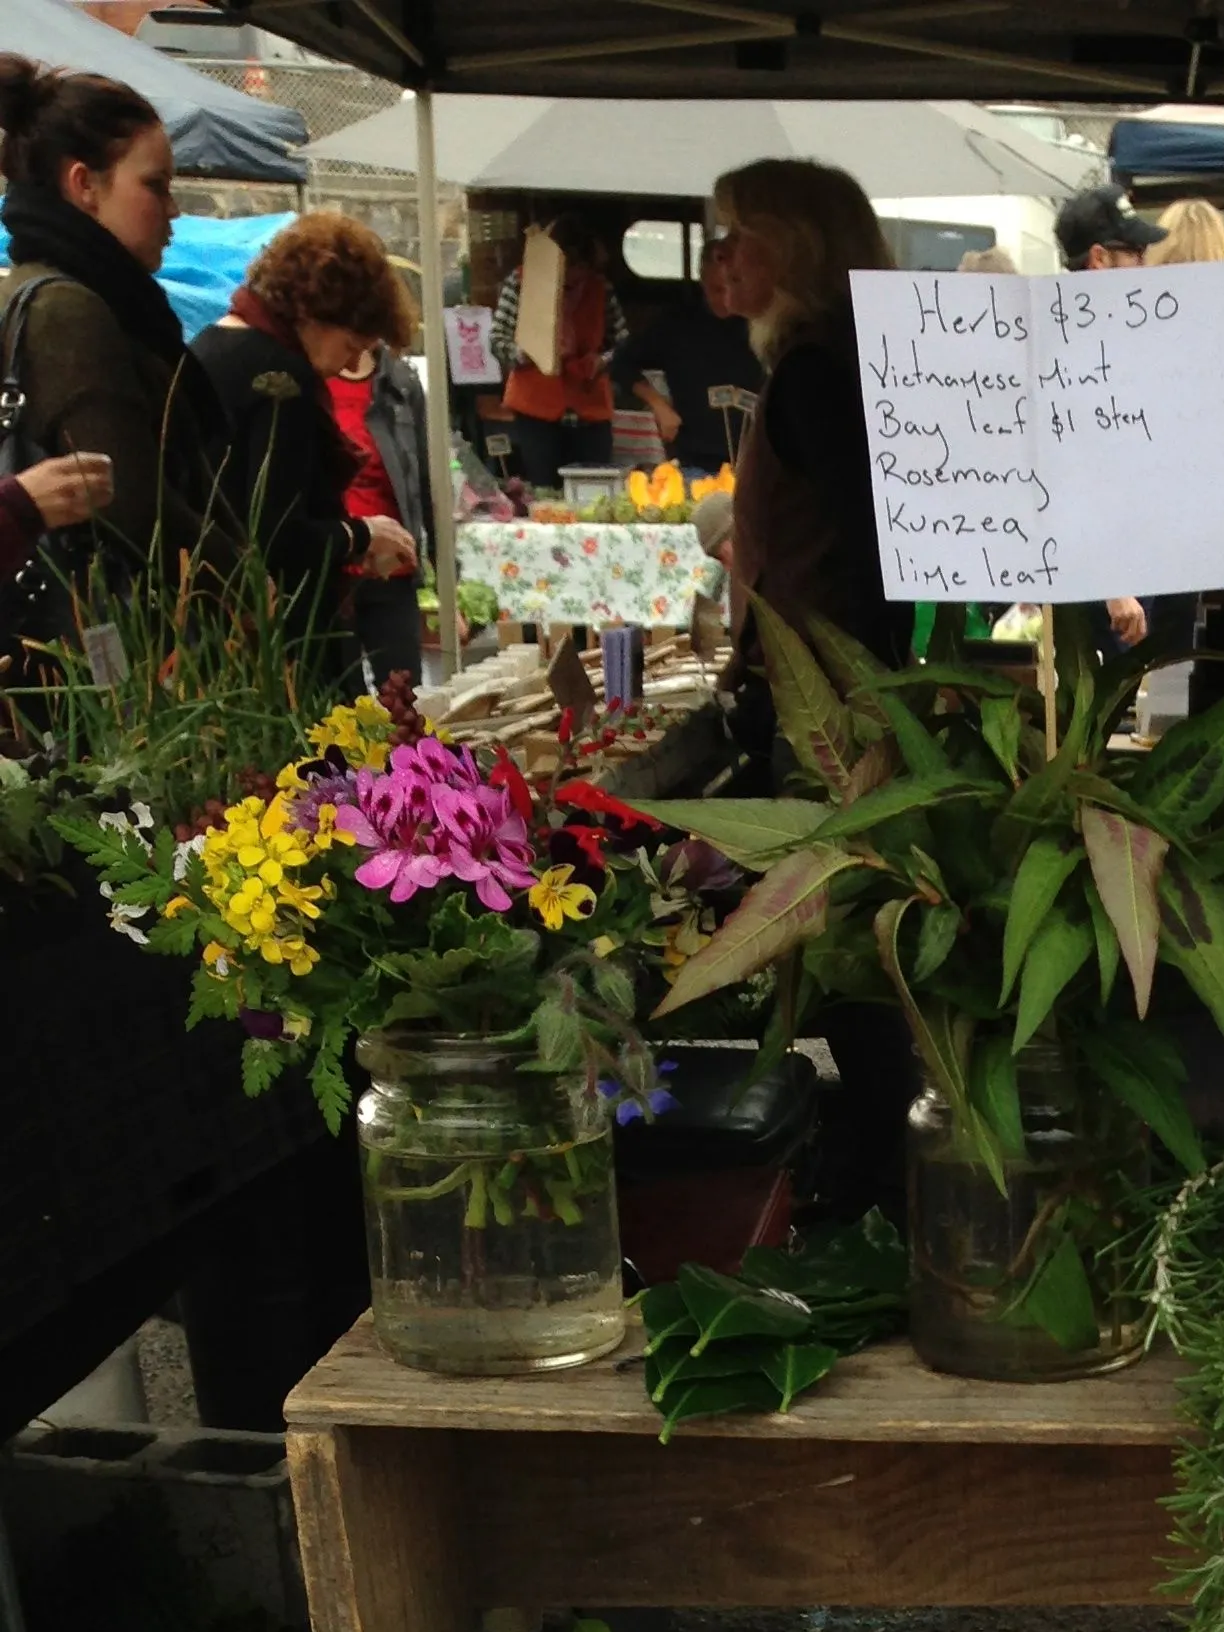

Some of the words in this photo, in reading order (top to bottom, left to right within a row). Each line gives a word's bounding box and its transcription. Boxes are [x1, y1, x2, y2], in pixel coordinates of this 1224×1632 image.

[913, 279, 1028, 341] Herbs
[1050, 281, 1179, 343] $3.50
[1038, 340, 1111, 390] Mint
[875, 400, 949, 469] Bay
[967, 397, 1027, 435] leaf
[1051, 401, 1074, 442] $1
[875, 451, 1050, 512] Rosemary
[885, 497, 1029, 543] Kunzea
[982, 537, 1059, 587] leaf
